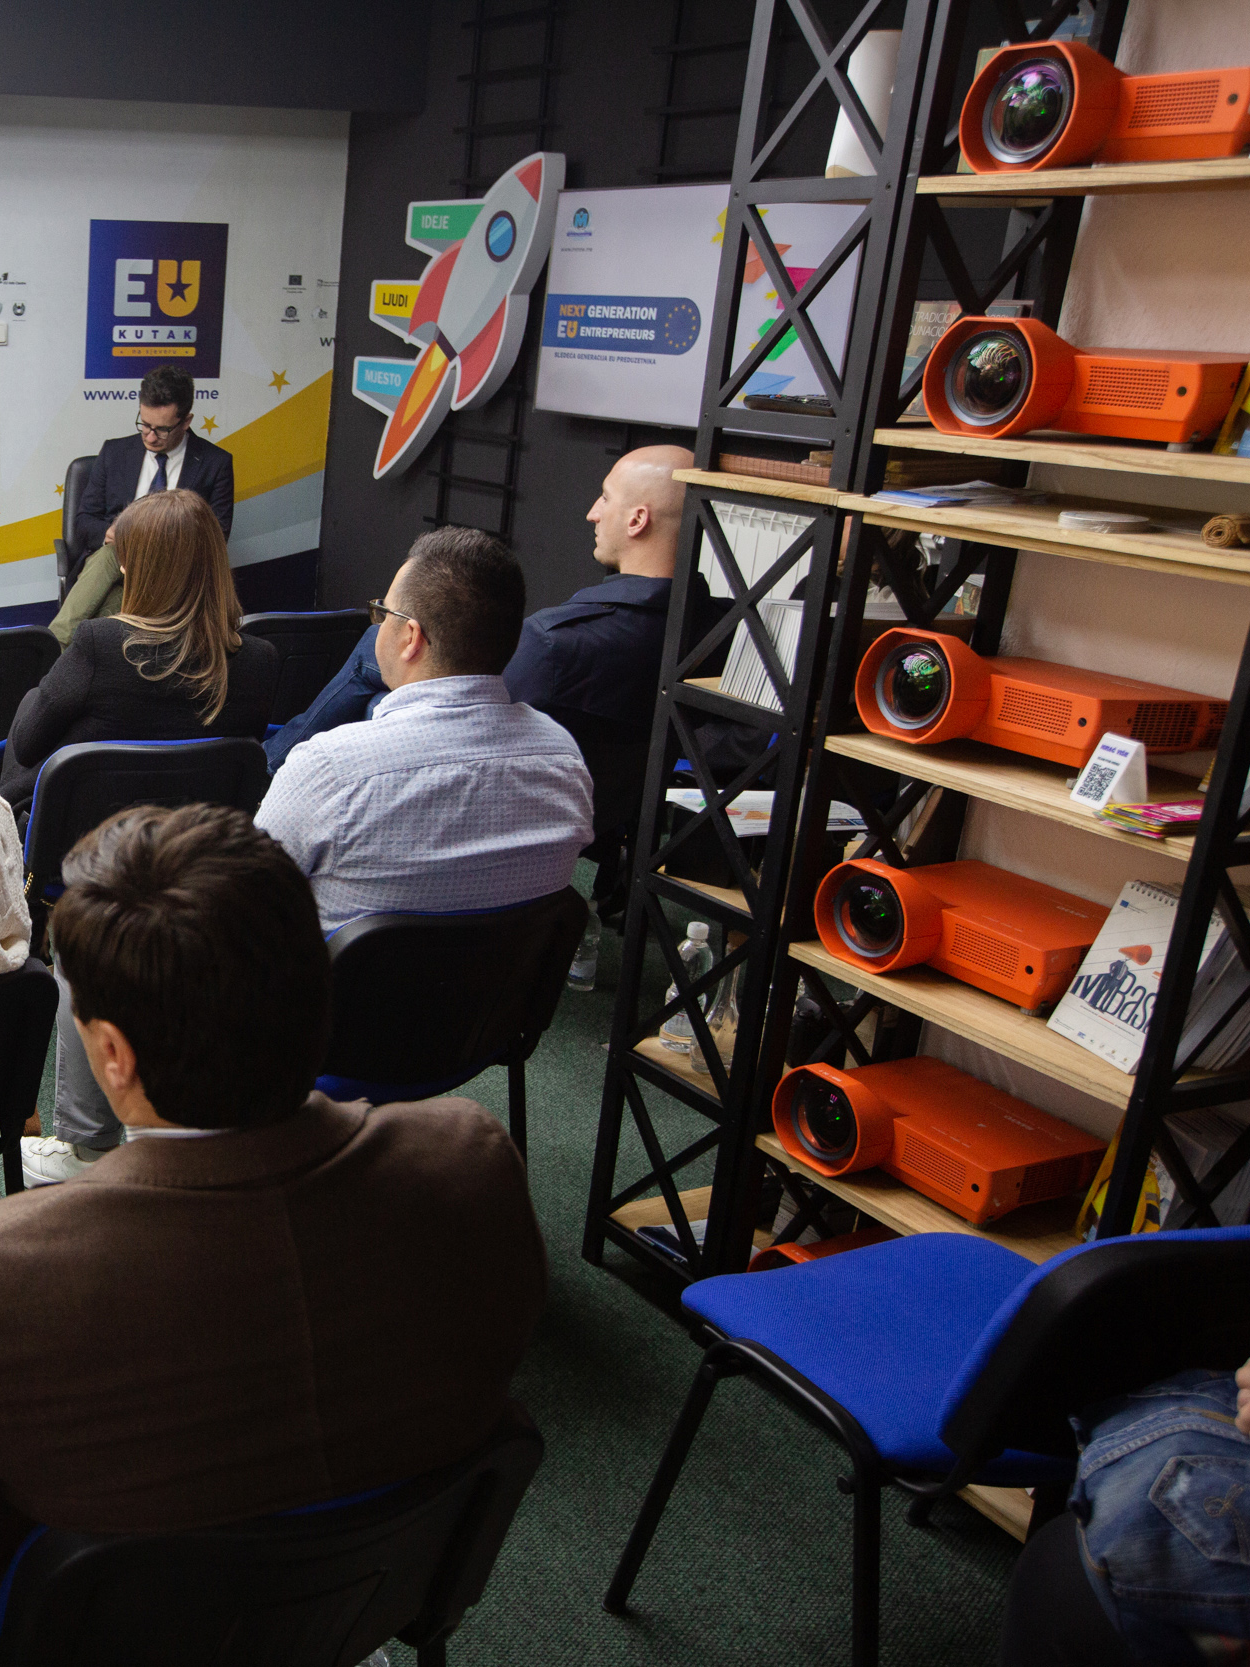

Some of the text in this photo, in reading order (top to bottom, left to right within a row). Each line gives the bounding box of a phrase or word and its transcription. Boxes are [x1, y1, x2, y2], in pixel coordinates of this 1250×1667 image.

[421, 215, 450, 229] IDEJE
[113, 258, 201, 318] EU
[382, 293, 409, 308] LJUDI
[559, 304, 657, 320] NEXT GENERATION
[118, 329, 192, 340] KUTAK
[557, 320, 655, 340] EU ENTREPRENEURS
[364, 369, 402, 387] MJESTO
